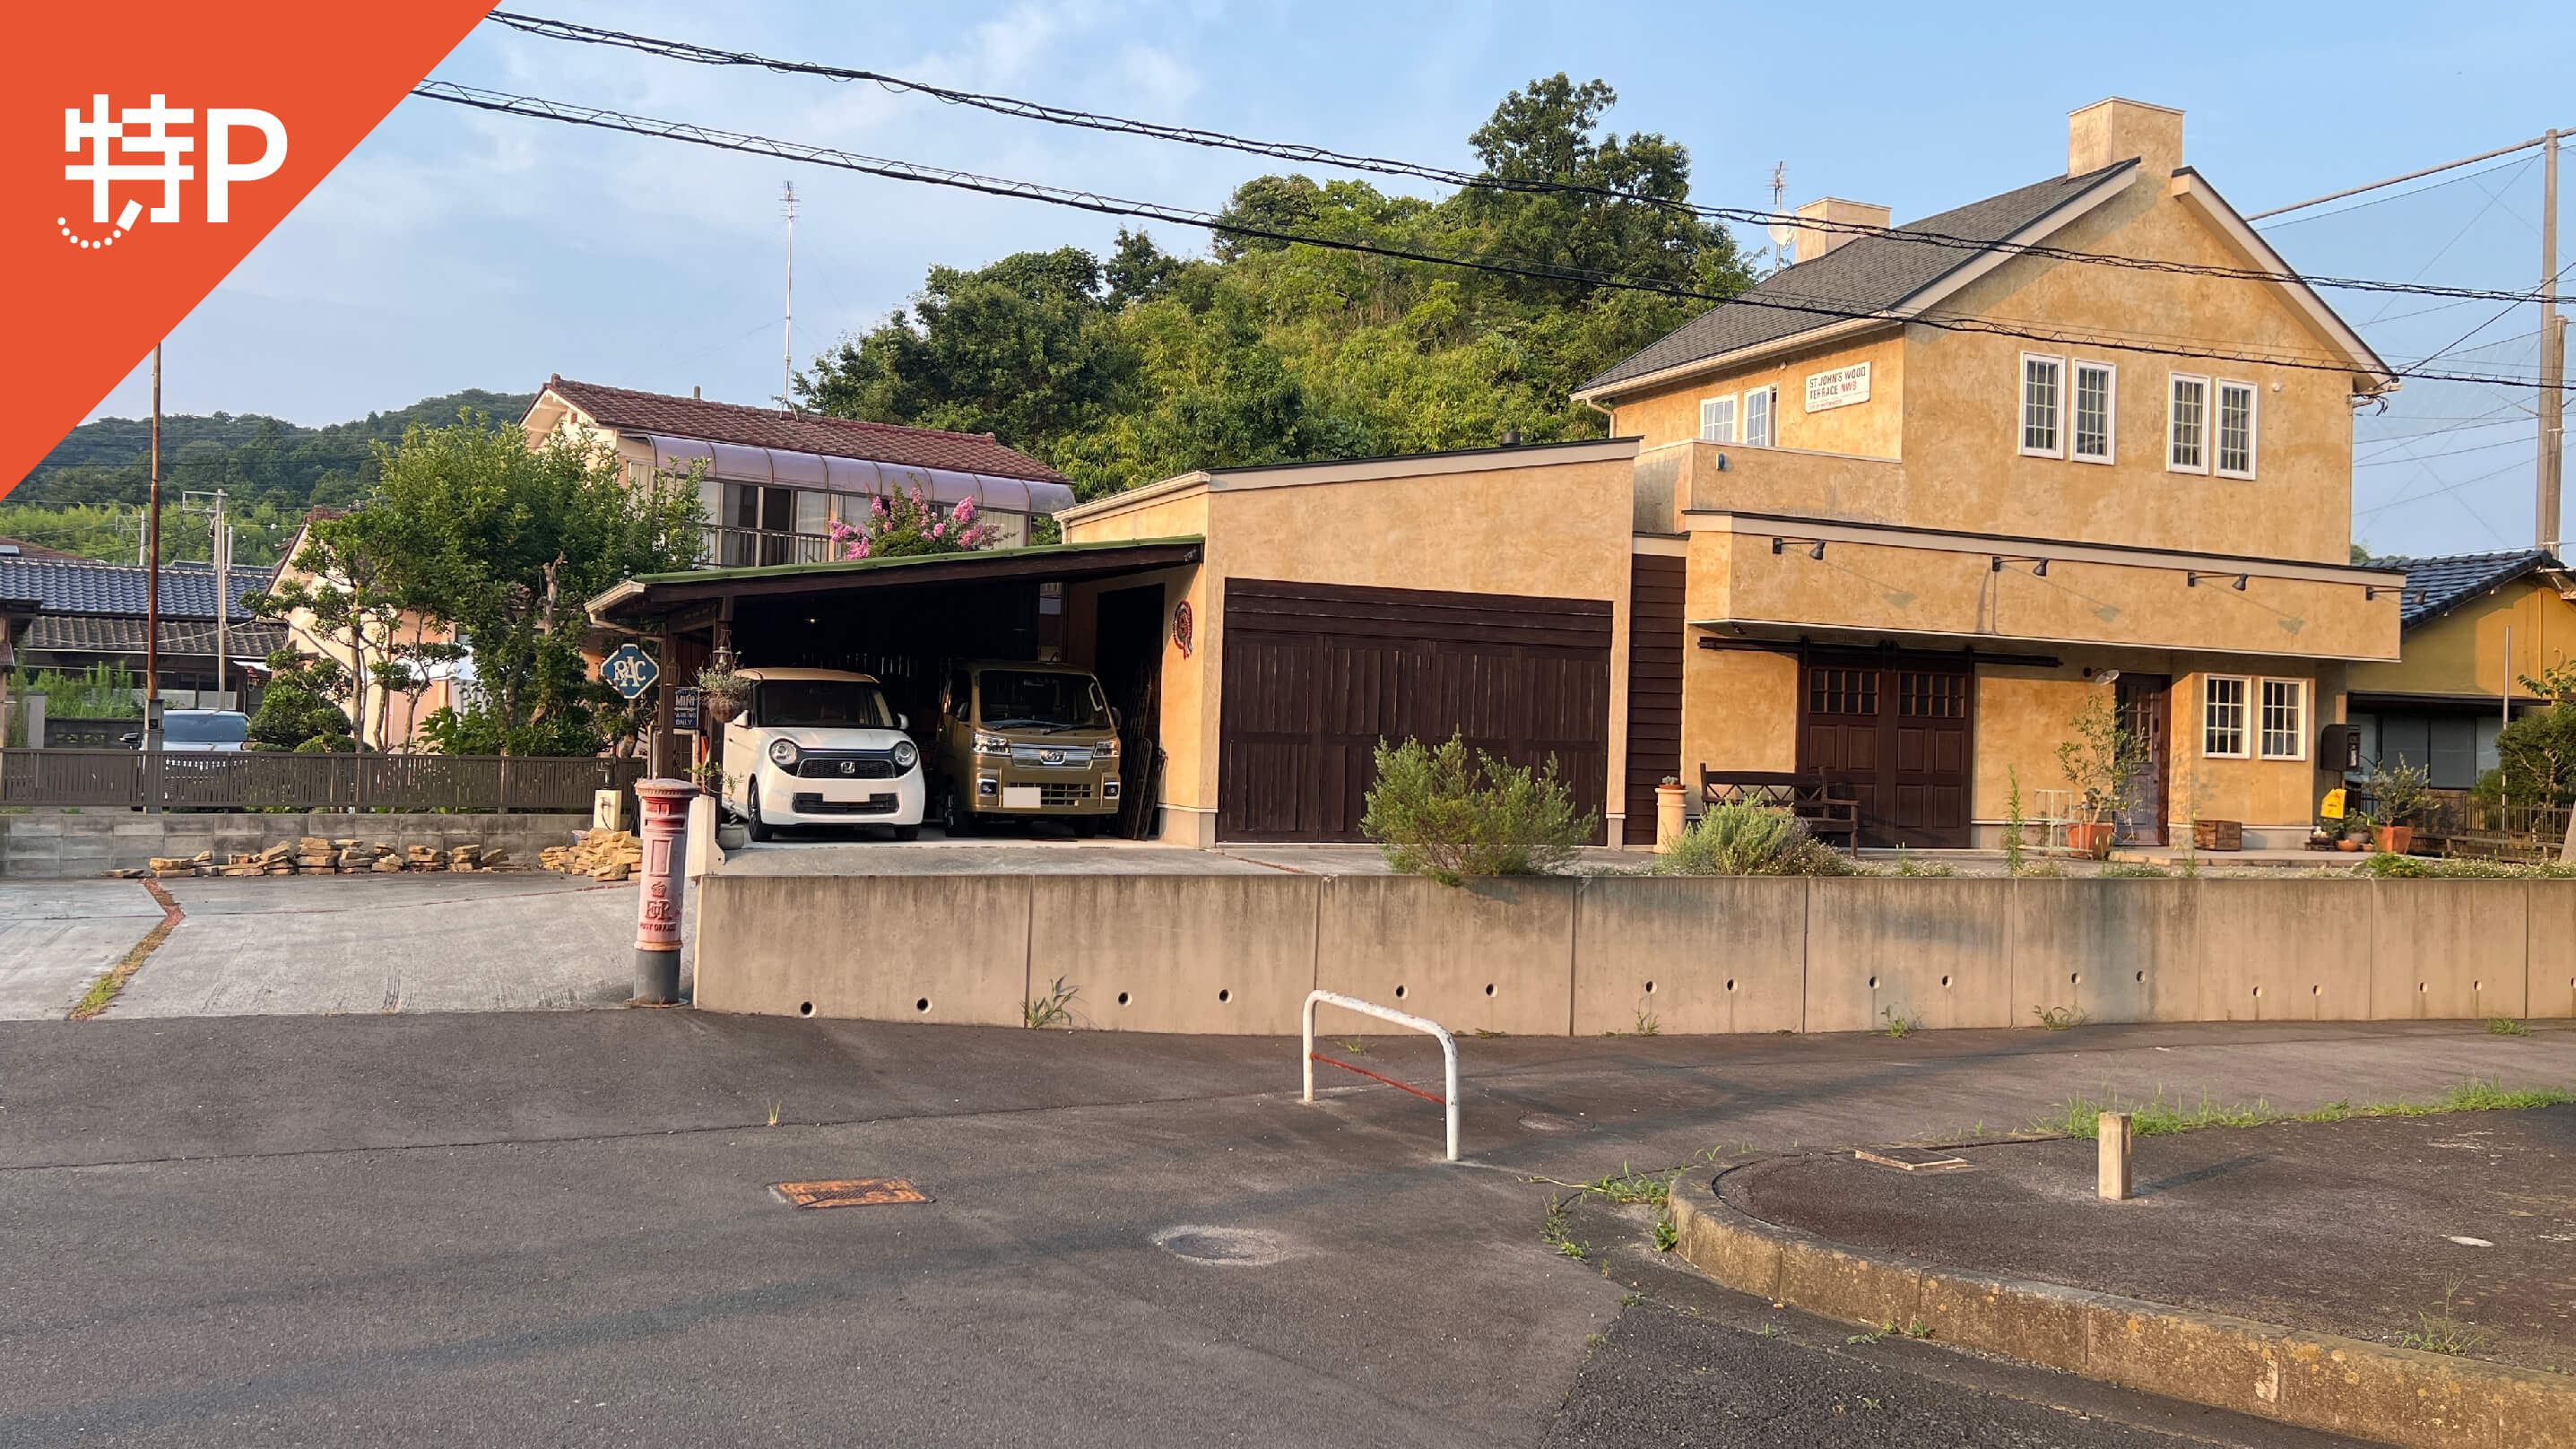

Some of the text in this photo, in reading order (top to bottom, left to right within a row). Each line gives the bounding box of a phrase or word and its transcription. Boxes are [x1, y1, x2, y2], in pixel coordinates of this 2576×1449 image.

[1810, 367, 1865, 388] ST JOHN'S WOOD
[1810, 386, 1838, 399] TERRACE
[613, 655, 646, 687] RAC
